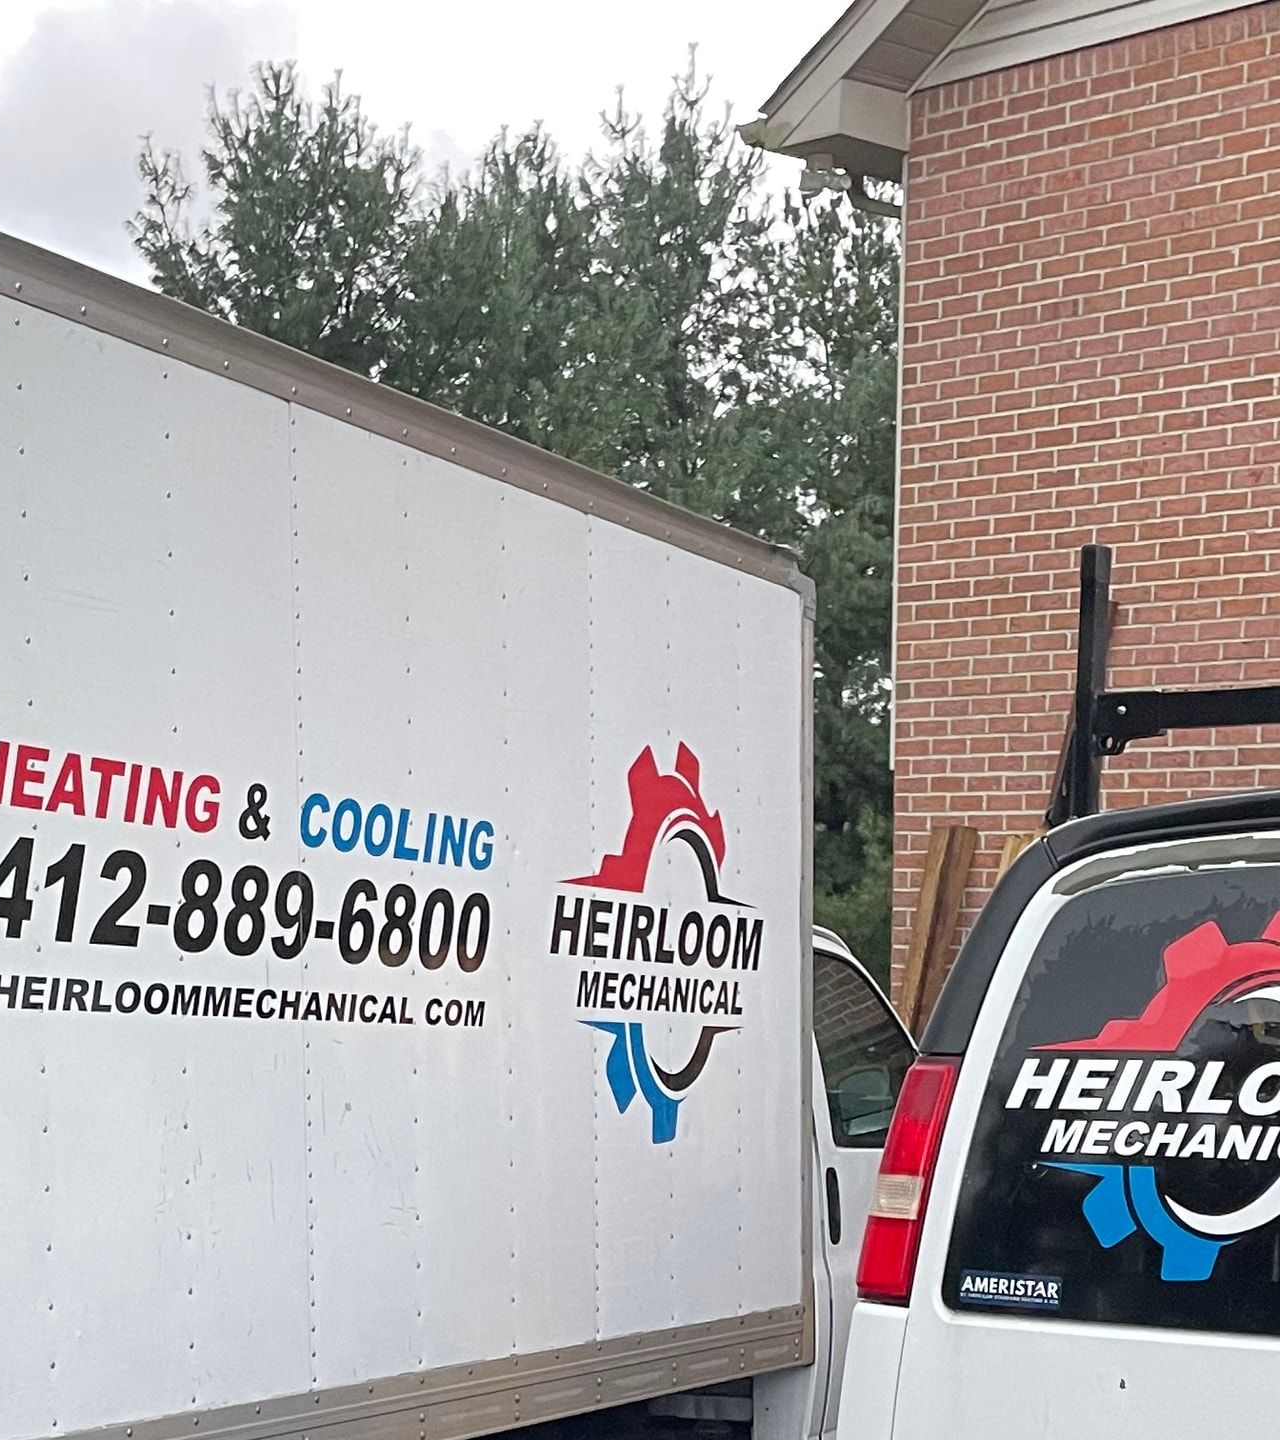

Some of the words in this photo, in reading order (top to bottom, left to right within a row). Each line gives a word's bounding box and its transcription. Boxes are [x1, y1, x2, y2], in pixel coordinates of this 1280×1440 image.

[238, 783, 271, 841] &
[300, 793, 494, 870] COOLING
[550, 895, 764, 971] HEIRLOOM
[576, 971, 742, 1015] MECHANICAL
[961, 1276, 1059, 1299] AMERISTAR
